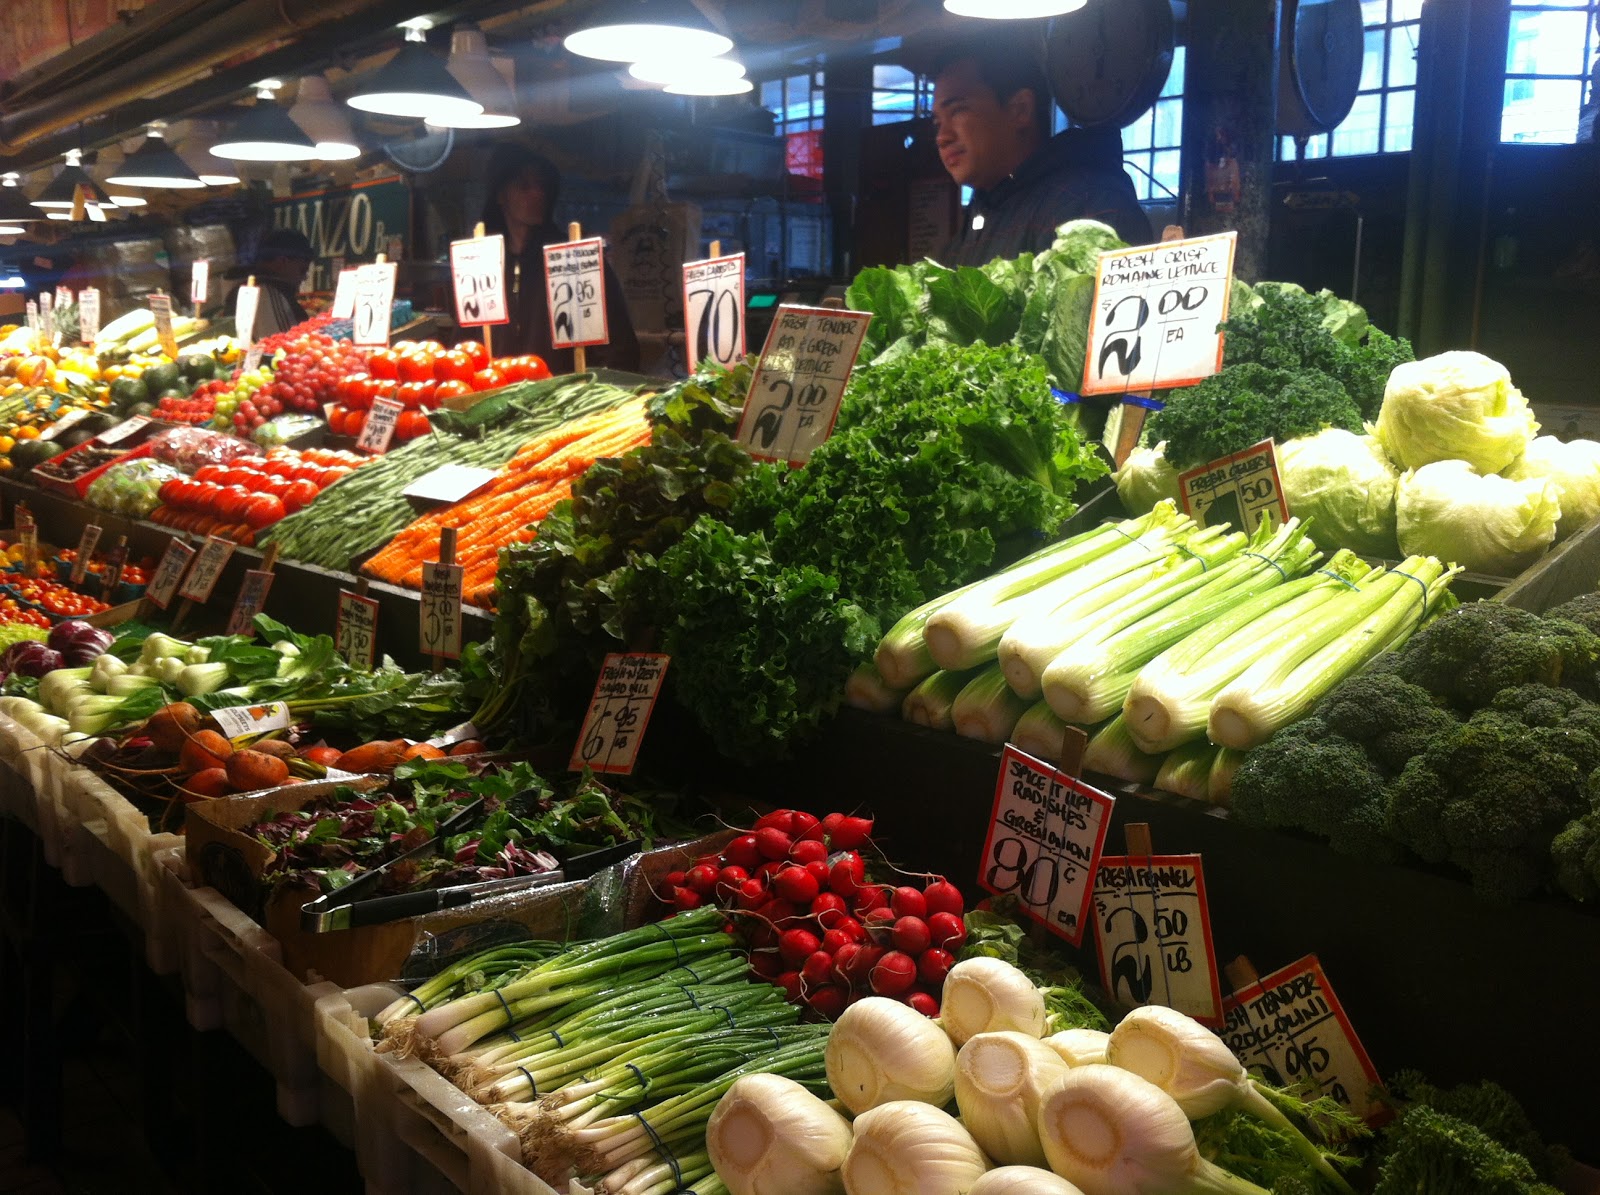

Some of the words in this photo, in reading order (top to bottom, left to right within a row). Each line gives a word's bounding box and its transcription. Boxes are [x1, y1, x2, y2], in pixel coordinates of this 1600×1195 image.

[1111, 250, 1153, 271] FRESH
[1165, 247, 1209, 264] CRISP
[1102, 268, 1164, 287] ROMAINE
[1168, 261, 1219, 279] LETTUCE
[1166, 327, 1184, 343] EA
[1240, 478, 1273, 504] 50
[1010, 761, 1047, 790] SPICE
[1050, 782, 1063, 798] IT
[1013, 780, 1087, 830] RADISHES
[1003, 809, 1047, 841] GREEN
[1048, 831, 1091, 861] ONION
[1095, 866, 1138, 888] FRESH
[1137, 866, 1196, 888] FENNEL
[1057, 910, 1077, 928] EA
[1154, 907, 1188, 939] 50
[1167, 947, 1192, 972] LB
[1249, 972, 1322, 1020] TENDER
[1285, 1036, 1330, 1076] 95
